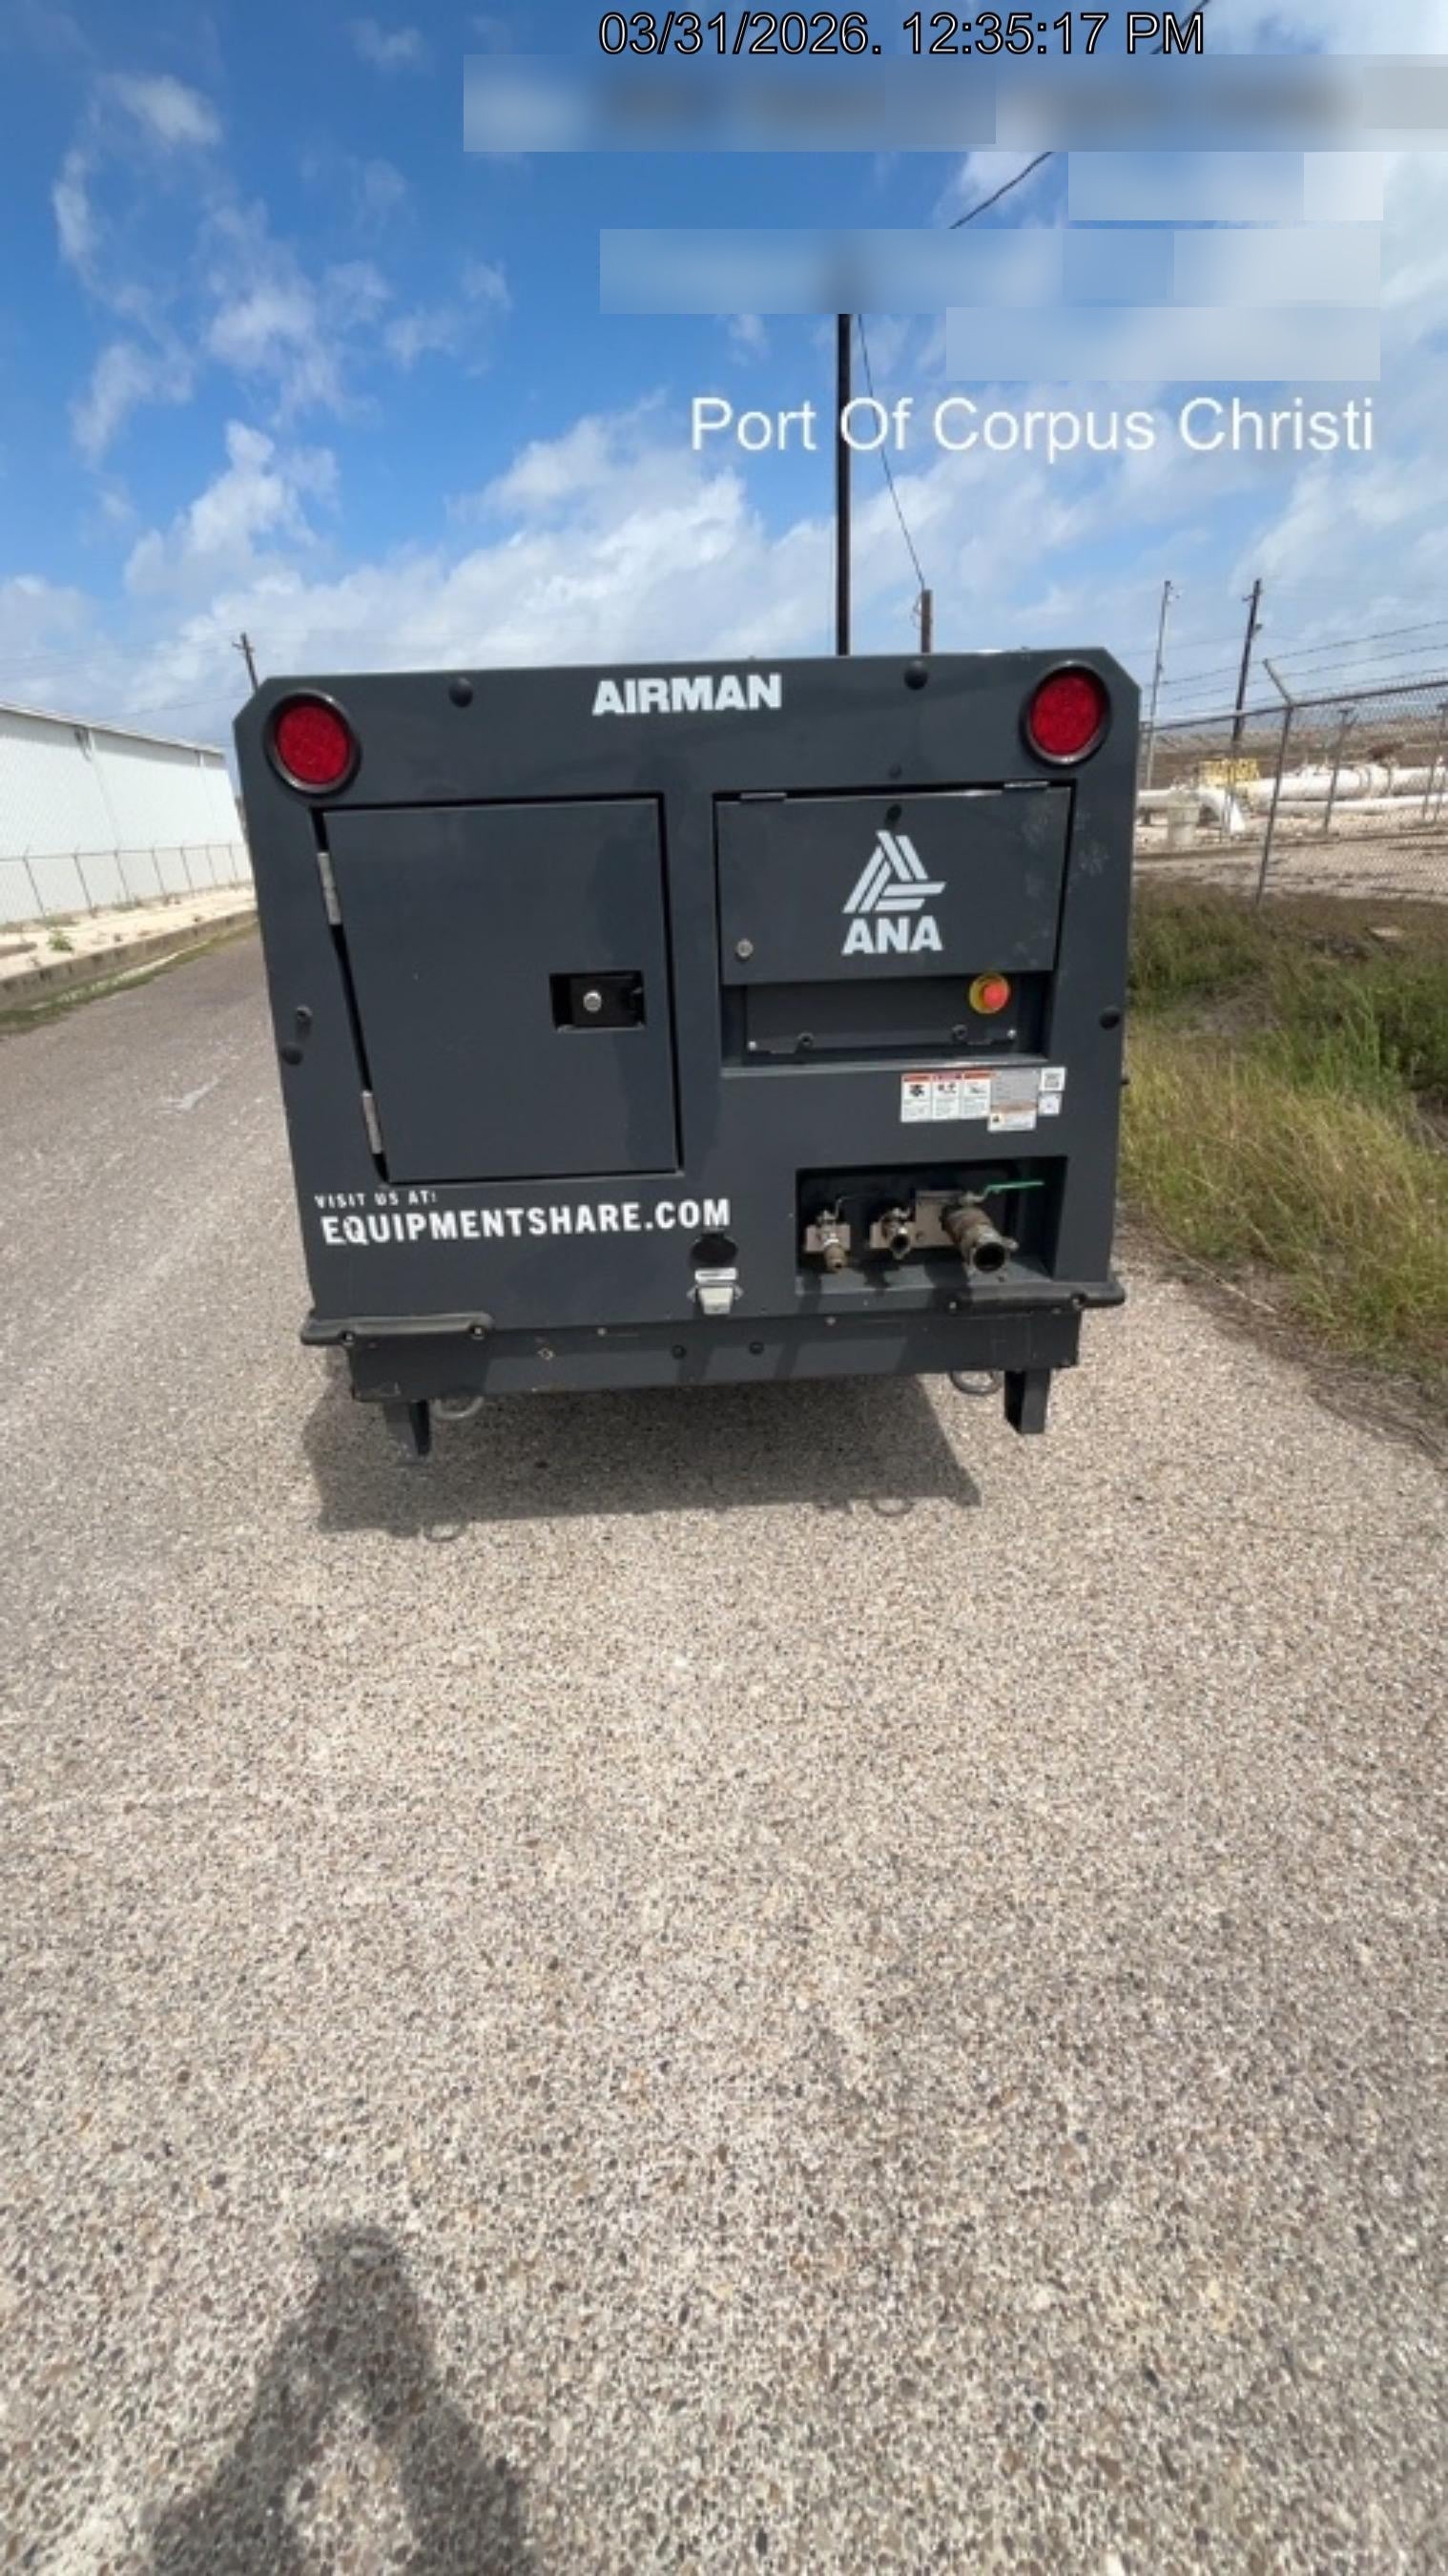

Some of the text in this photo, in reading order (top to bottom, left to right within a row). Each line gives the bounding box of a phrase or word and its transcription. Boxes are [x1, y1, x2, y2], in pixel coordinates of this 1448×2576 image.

[592, 673, 782, 717] AIRMAN
[841, 915, 942, 955] ANA
[314, 1193, 365, 1209] VISIT
[374, 1191, 399, 1206] US
[321, 1198, 732, 1245] EQUIPMENTSHARE.COM
